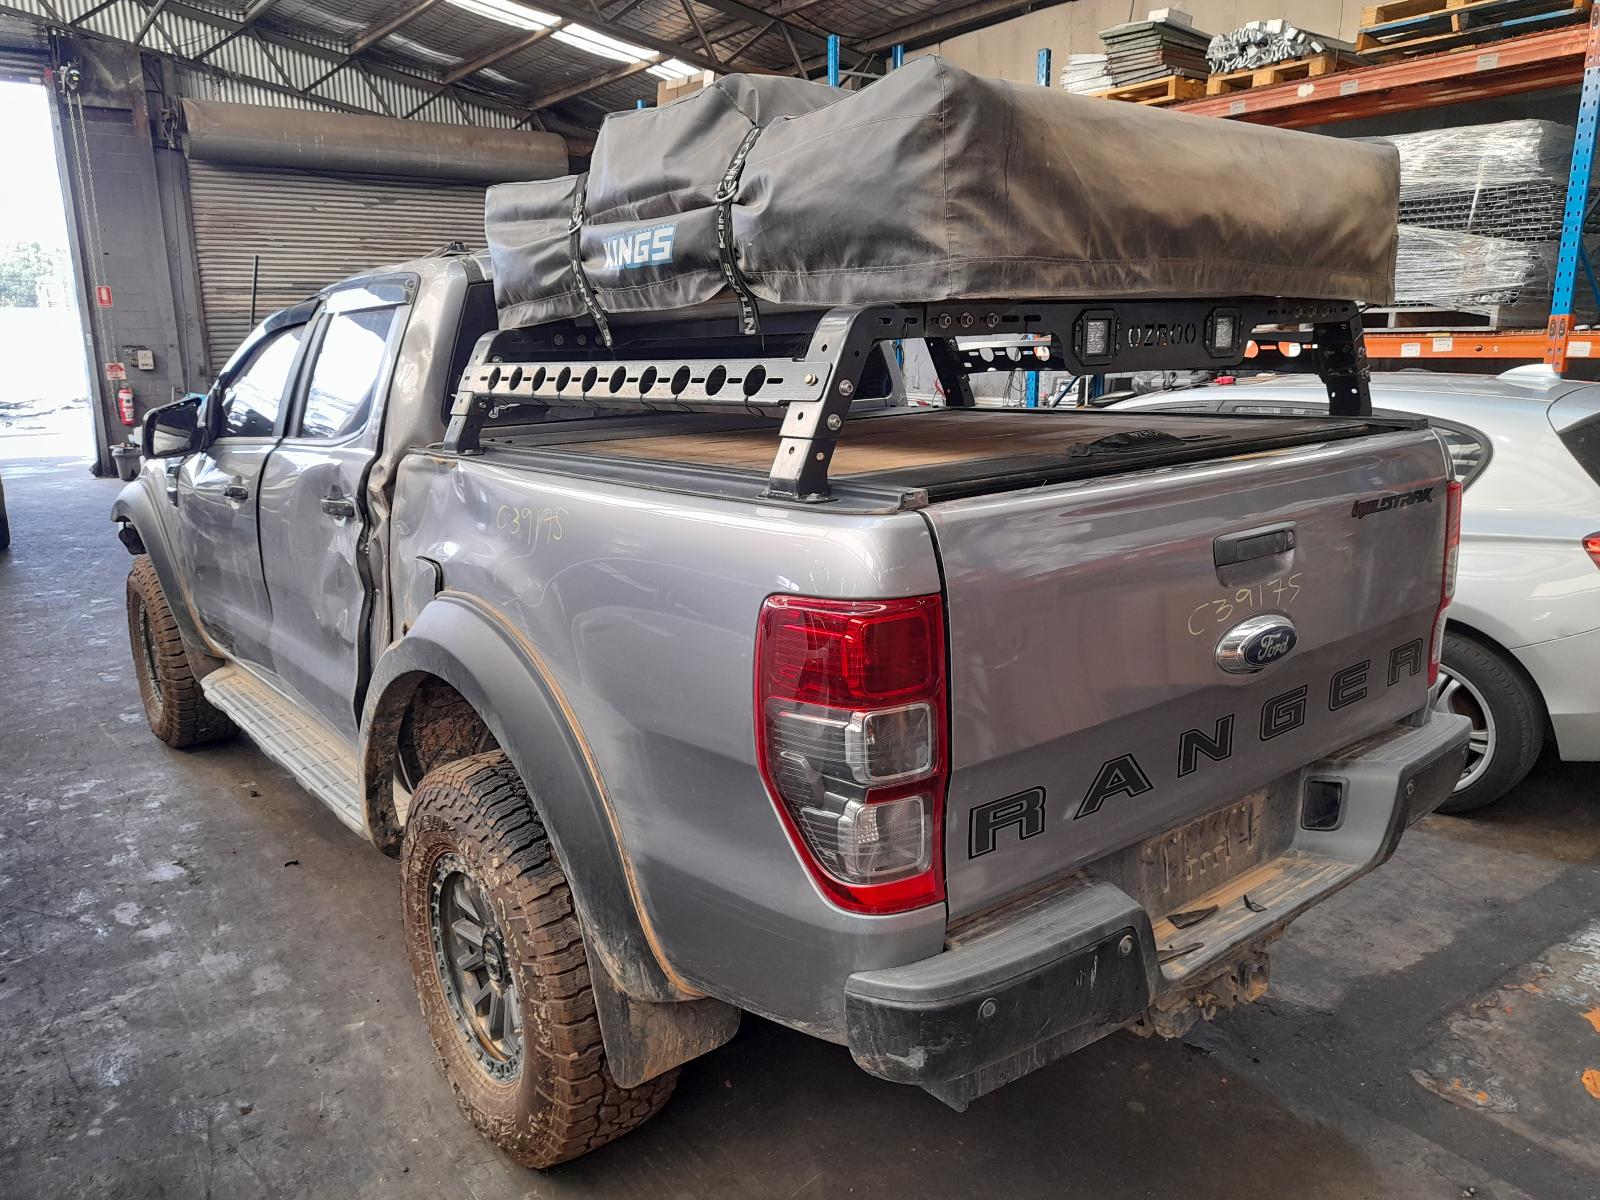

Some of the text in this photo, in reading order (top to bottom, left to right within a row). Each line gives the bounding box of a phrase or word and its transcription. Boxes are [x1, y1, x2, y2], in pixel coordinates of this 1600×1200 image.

[497, 505, 569, 545] C39175
[1187, 573, 1302, 635] C39175
[1258, 633, 1289, 661] Ford
[968, 639, 1422, 860] RANGER
